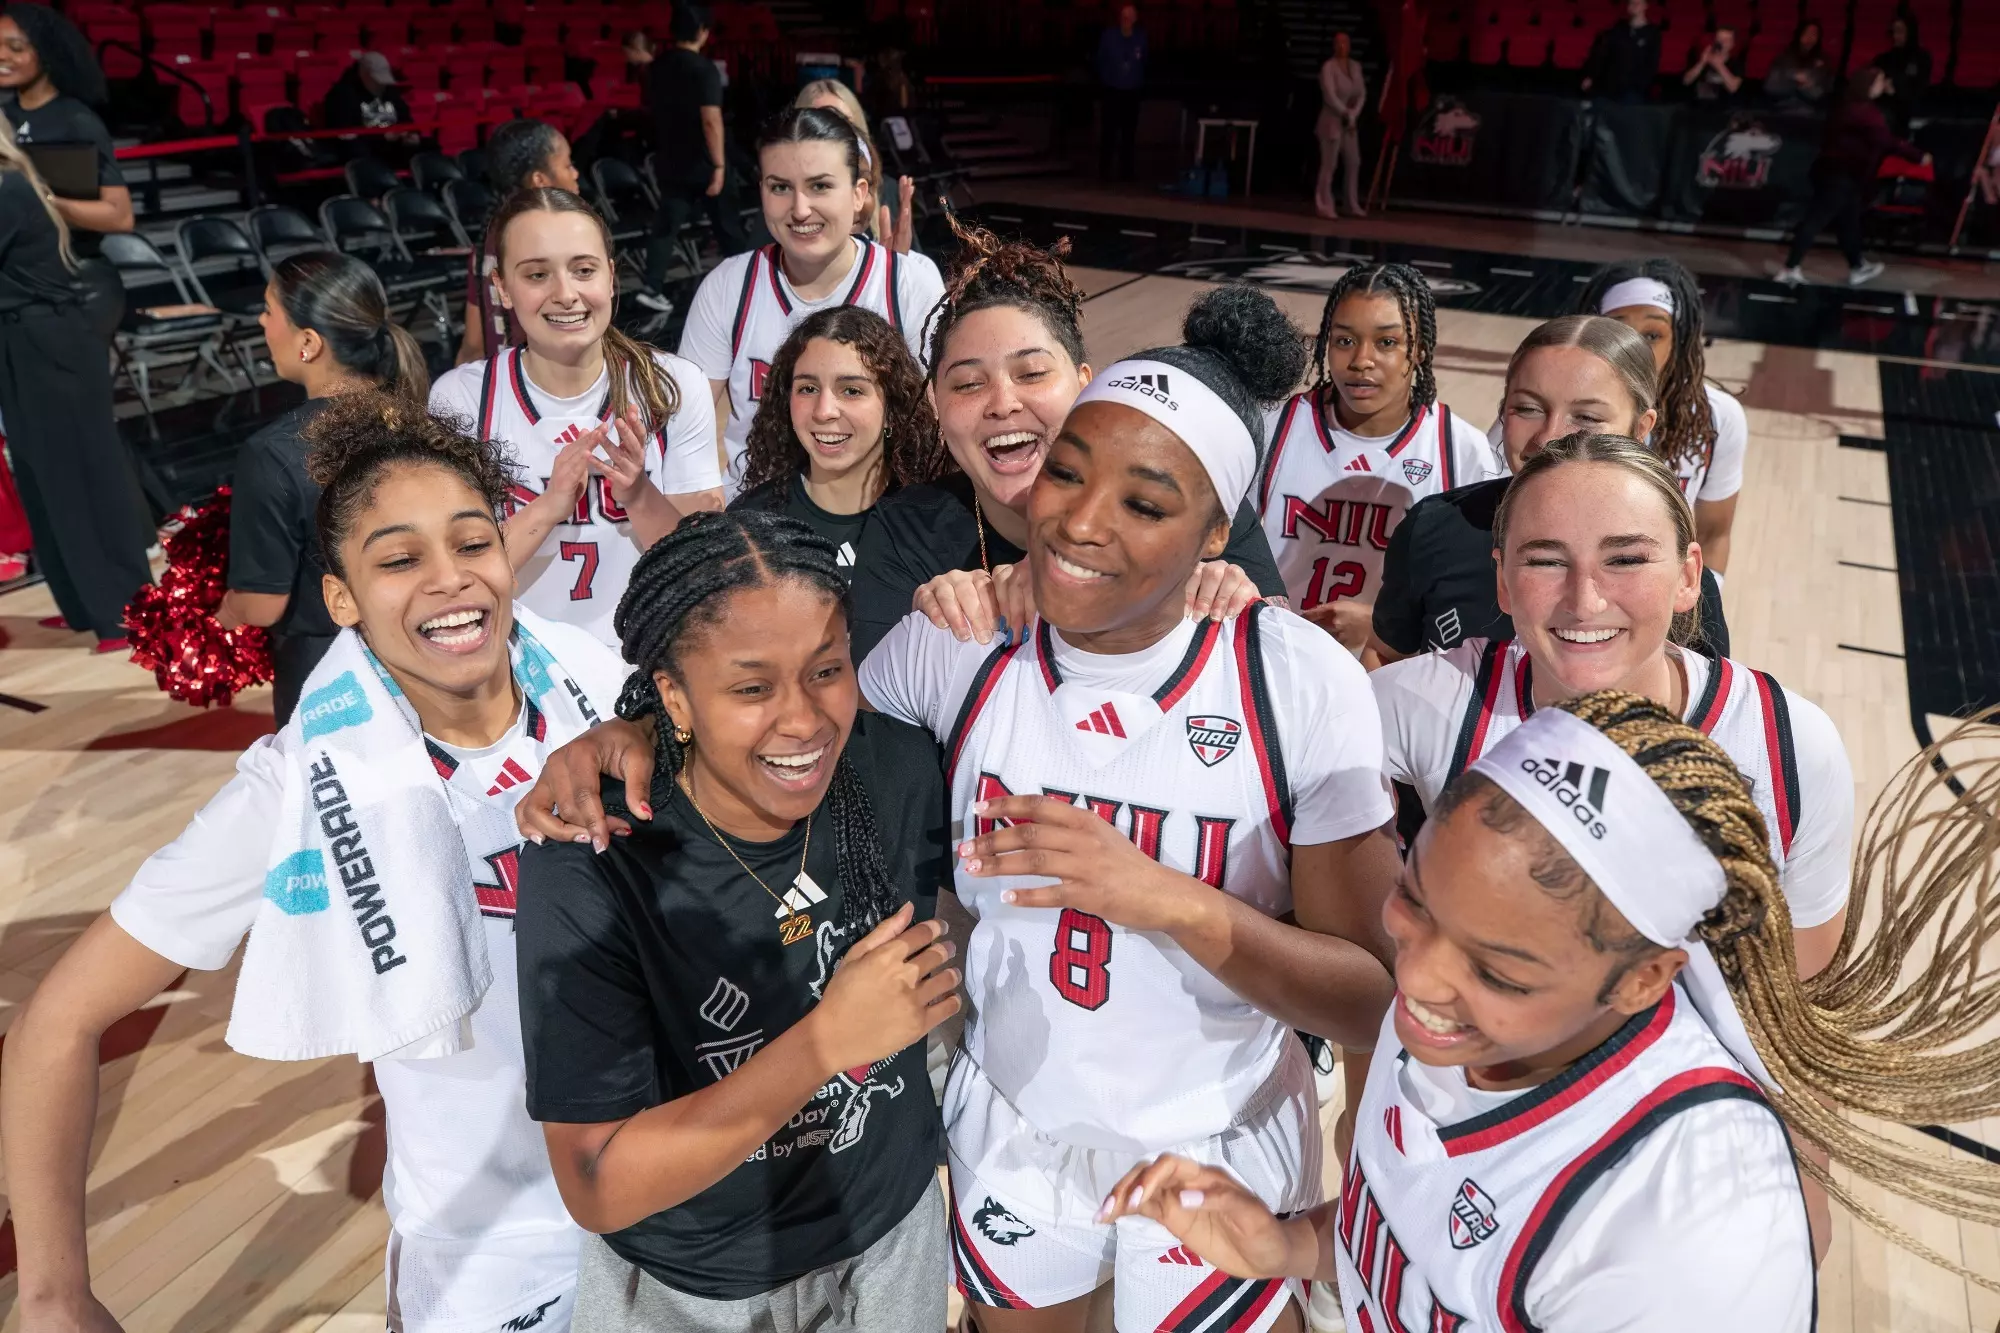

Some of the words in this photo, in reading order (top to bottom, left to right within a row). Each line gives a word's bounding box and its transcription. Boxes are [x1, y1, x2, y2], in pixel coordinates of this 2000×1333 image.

[1699, 155, 1768, 185] NIU
[1107, 379, 1179, 411] adidas
[1403, 465, 1431, 477] MAC
[1281, 494, 1412, 551] NIU
[560, 541, 600, 601] 7
[1301, 556, 1367, 610] 12
[302, 690, 358, 726] RADE
[1188, 728, 1239, 748] MAC
[1521, 759, 1607, 840] adidas
[309, 752, 407, 975] POWERADE
[779, 914, 814, 946] 22
[1049, 908, 1113, 1012] 8
[811, 1081, 842, 1101] en
[772, 1140, 795, 1159] by
